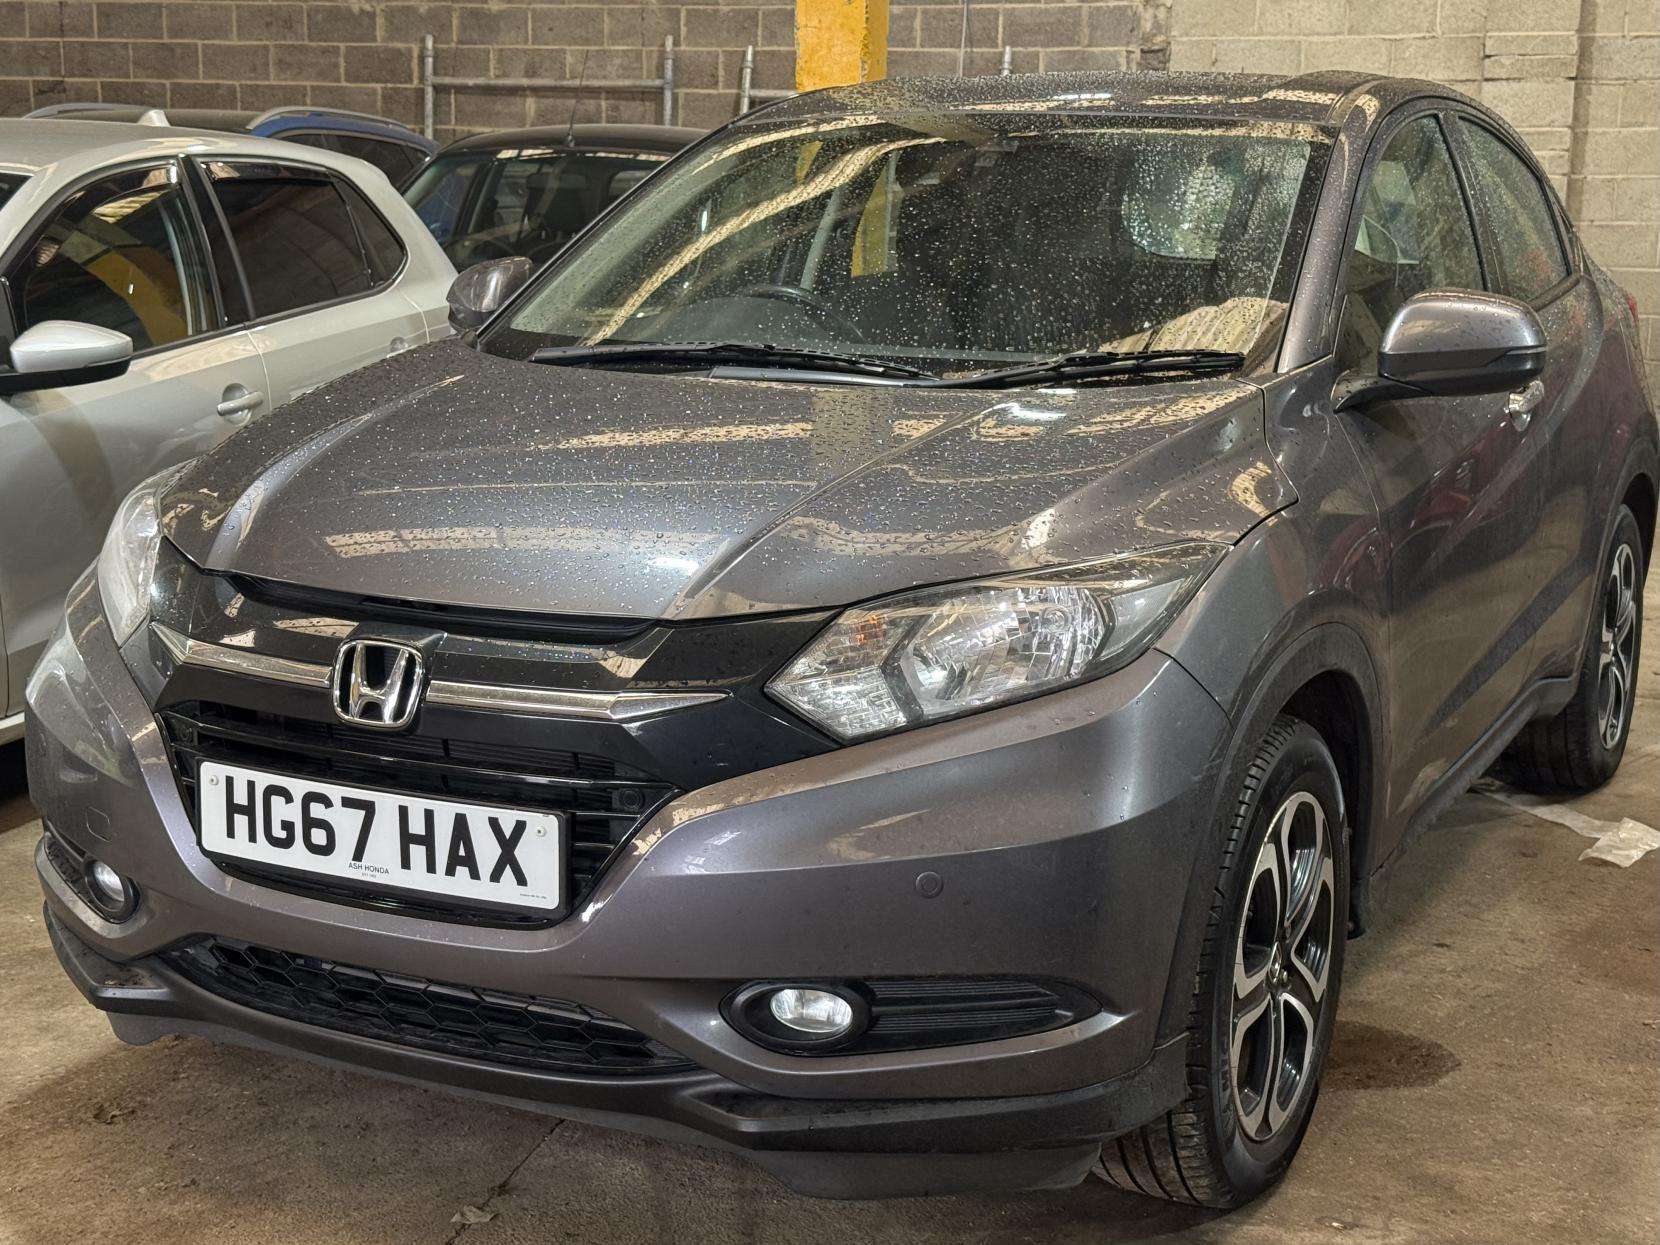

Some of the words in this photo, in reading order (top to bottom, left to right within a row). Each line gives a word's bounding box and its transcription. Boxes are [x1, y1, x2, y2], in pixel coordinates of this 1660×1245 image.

[225, 775, 376, 863] HG67
[398, 804, 528, 887] HAX
[348, 862, 363, 870] ASH
[364, 864, 390, 875] HONDA
